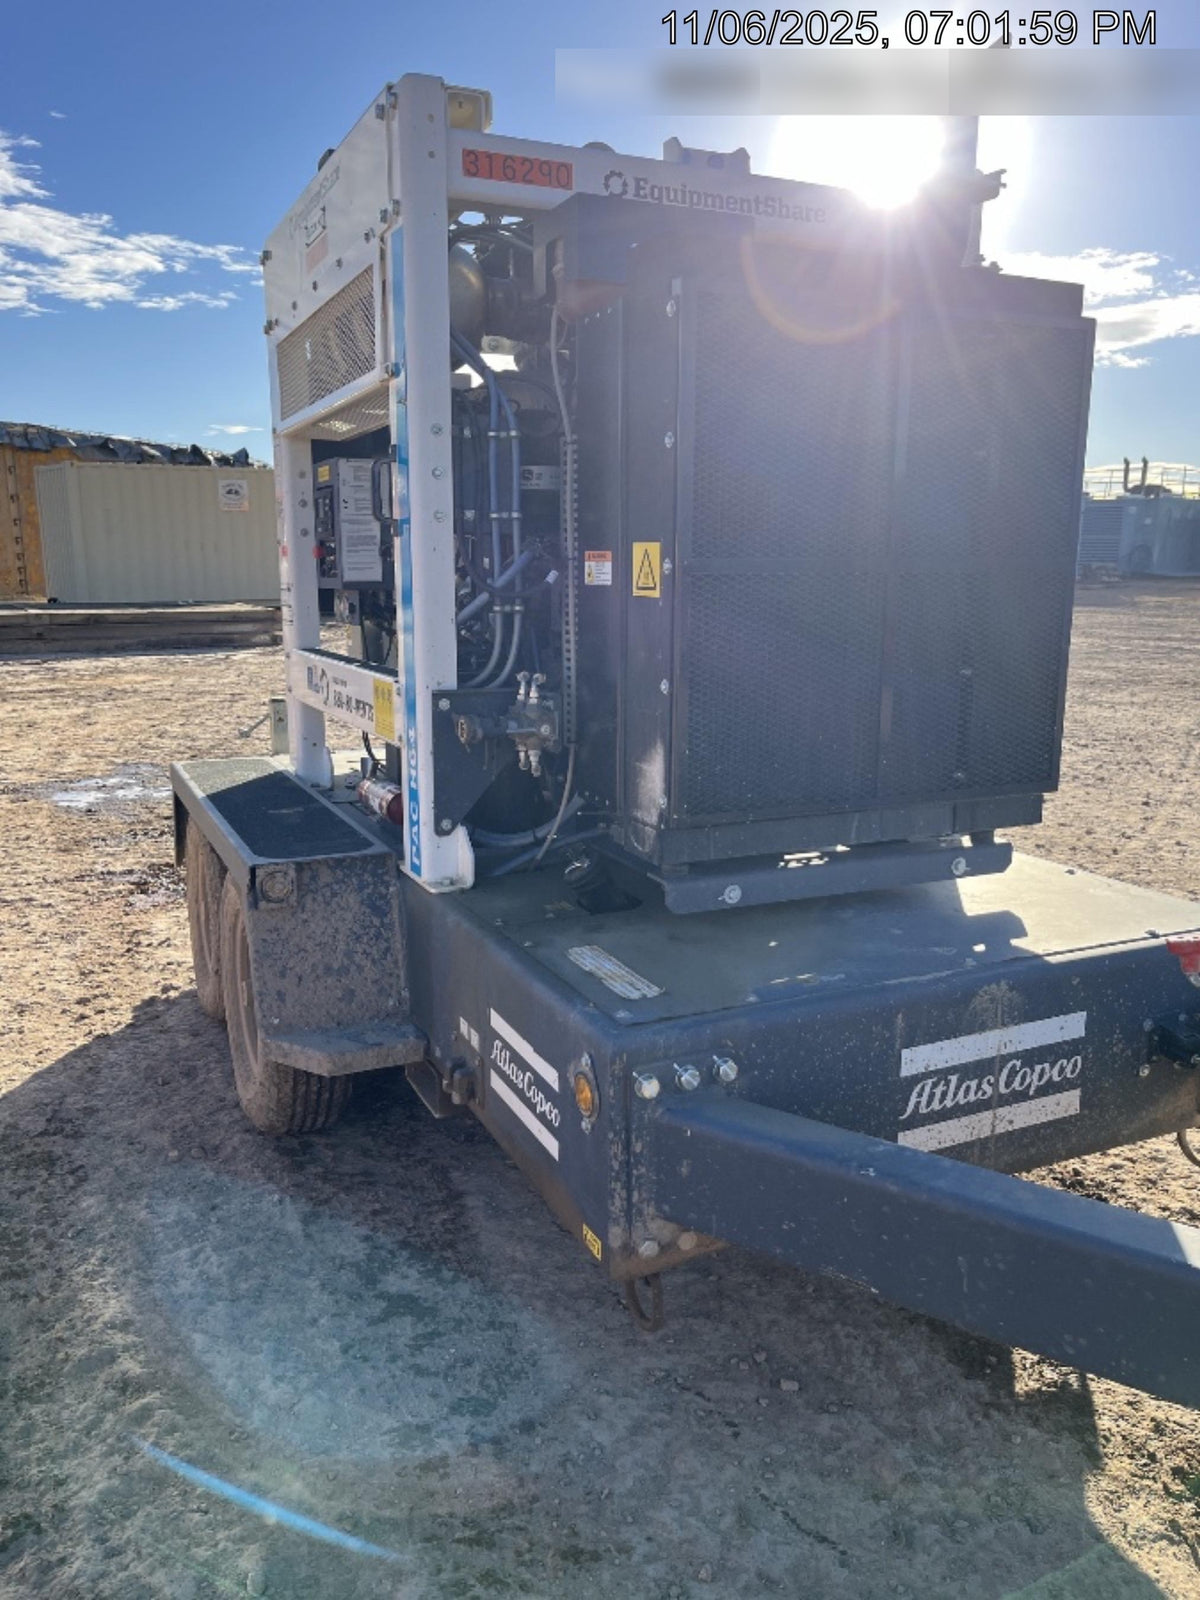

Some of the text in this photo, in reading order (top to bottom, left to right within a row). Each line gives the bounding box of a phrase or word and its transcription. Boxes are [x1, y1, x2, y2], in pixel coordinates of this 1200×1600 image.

[463, 149, 571, 189] 316290
[633, 176, 827, 224] EquipmentShare
[410, 801, 421, 866] PAC
[899, 1055, 1083, 1120] Atlas Copco
